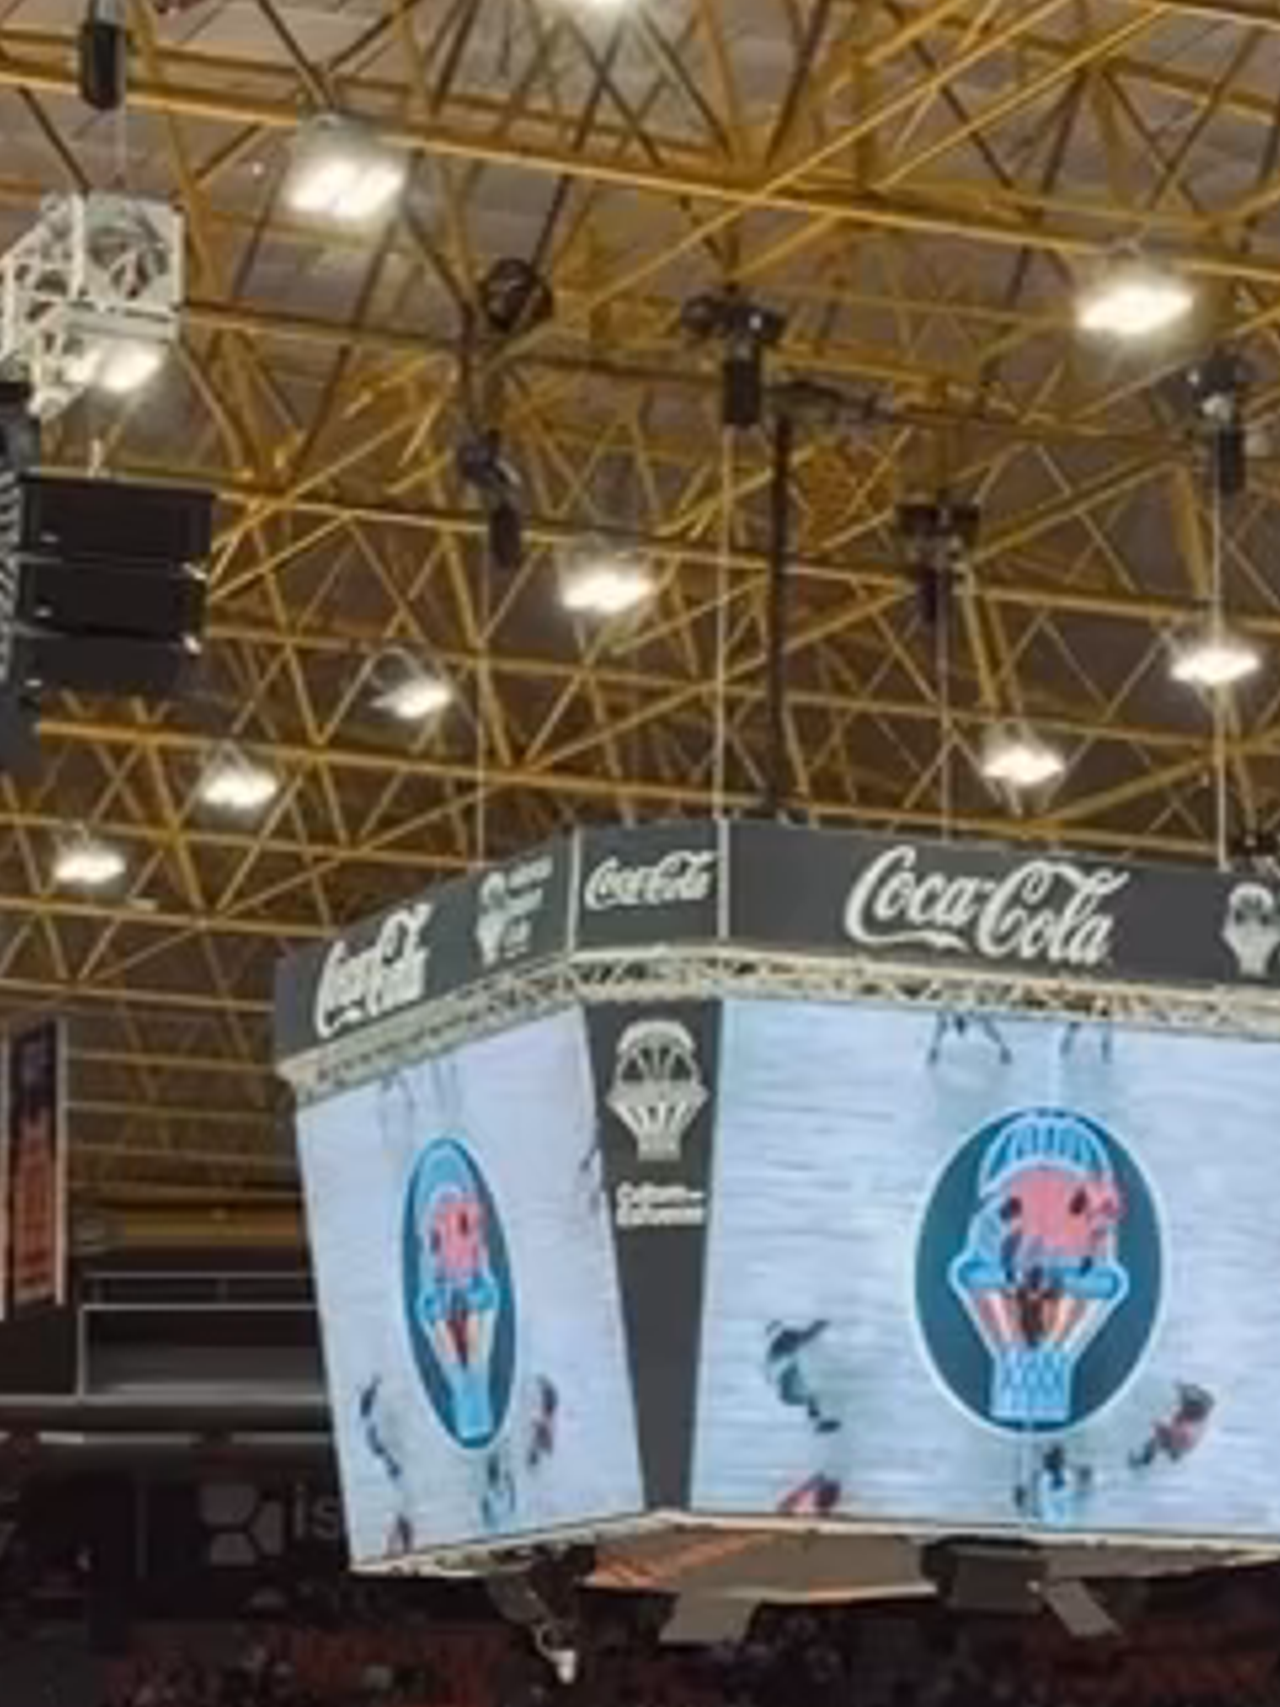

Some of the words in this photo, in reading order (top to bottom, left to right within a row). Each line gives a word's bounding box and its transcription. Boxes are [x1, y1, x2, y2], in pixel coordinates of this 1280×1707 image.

[584, 850, 718, 911] Coca-Cola
[845, 845, 1131, 965] Coca-Cola
[316, 902, 433, 1039] Coca-Cola
